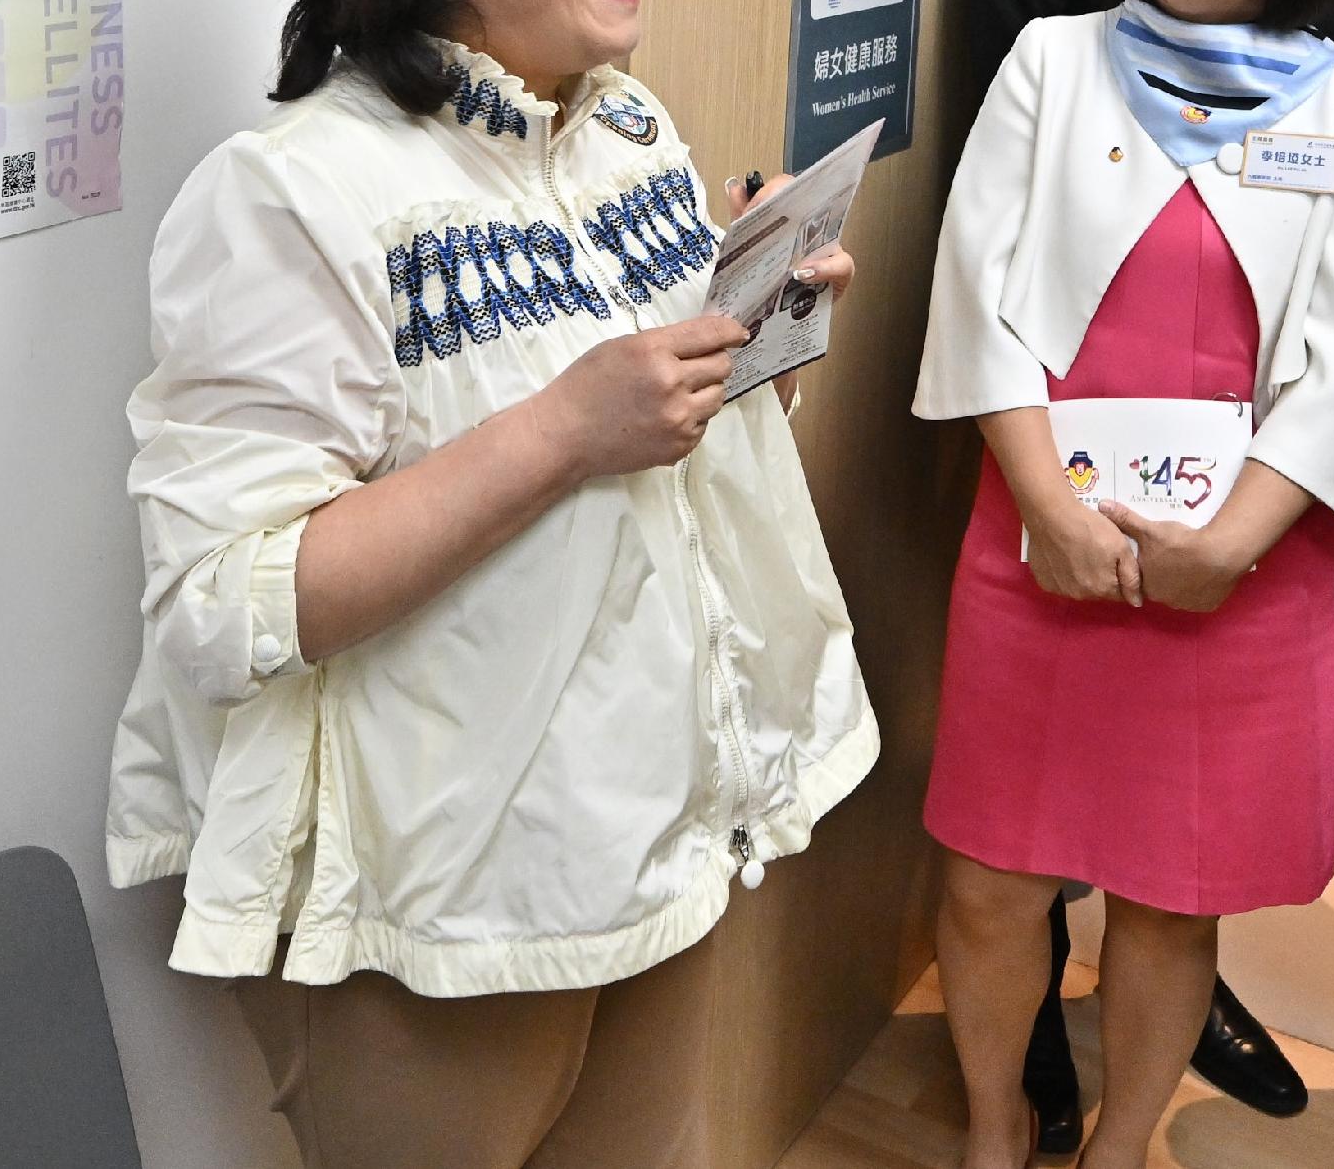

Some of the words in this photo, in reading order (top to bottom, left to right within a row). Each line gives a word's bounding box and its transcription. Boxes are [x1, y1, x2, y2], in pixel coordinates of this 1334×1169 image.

[814, 34, 898, 82] 婦女健康服務
[812, 92, 847, 117] Women's
[848, 88, 871, 107] Health
[873, 83, 896, 100] Service
